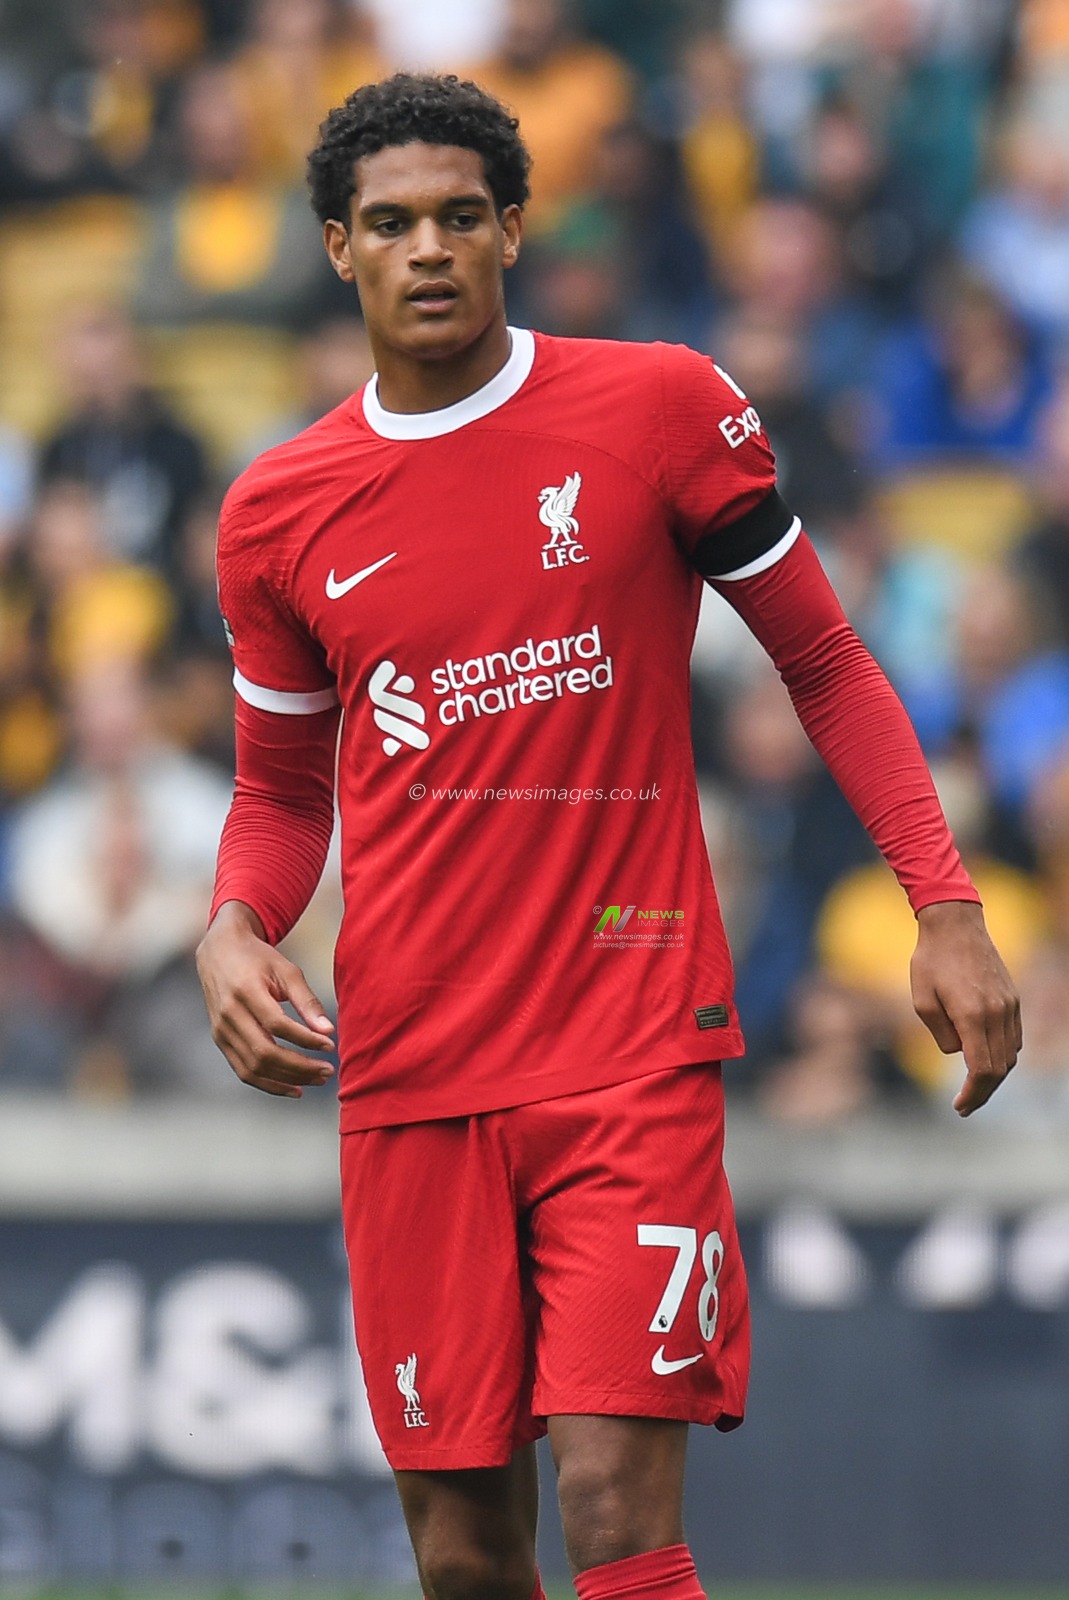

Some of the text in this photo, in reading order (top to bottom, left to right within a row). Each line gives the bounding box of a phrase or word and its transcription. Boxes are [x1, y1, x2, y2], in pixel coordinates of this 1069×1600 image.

[431, 624, 602, 695] standard
[438, 655, 614, 726] chartered
[637, 1224, 724, 1342] 78
